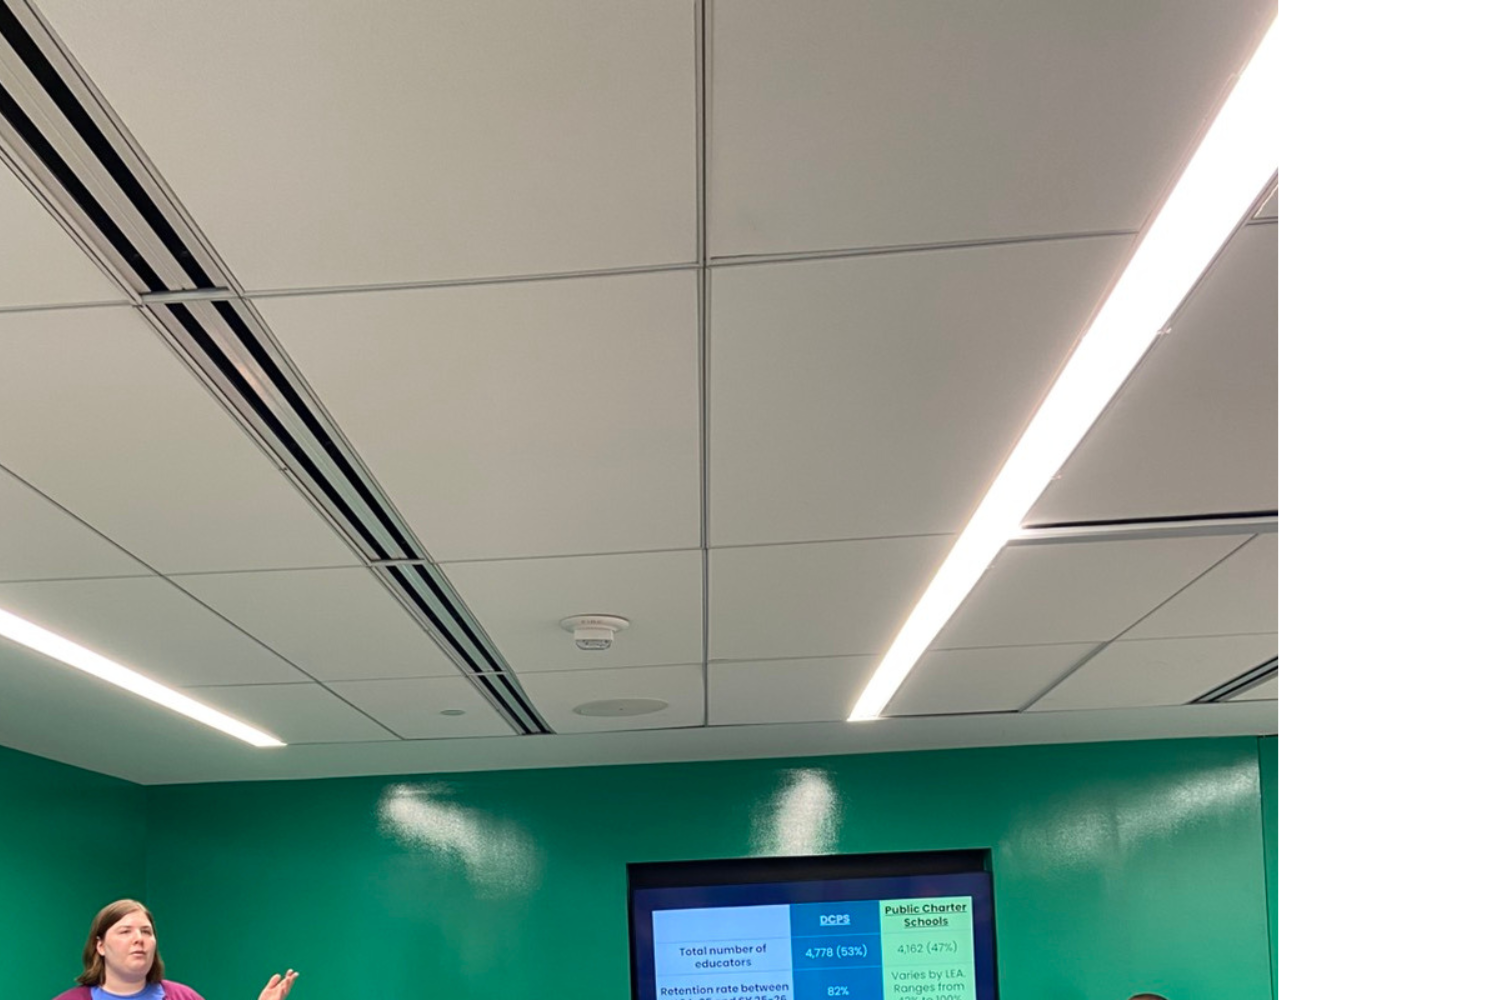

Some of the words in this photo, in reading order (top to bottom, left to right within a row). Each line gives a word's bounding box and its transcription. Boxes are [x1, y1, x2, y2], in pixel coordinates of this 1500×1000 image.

[885, 904, 920, 915] Public
[922, 903, 967, 914] Charter
[820, 914, 851, 926] DCPS
[904, 916, 949, 928] Schools
[679, 946, 706, 957] Total
[709, 944, 753, 956] number
[755, 943, 767, 953] of
[805, 948, 833, 960] 4,778
[837, 943, 868, 959] (53%)
[897, 943, 923, 955] 4,162
[926, 940, 957, 954] (47%)
[695, 958, 752, 969] educators
[891, 970, 926, 981] Varies
[928, 969, 943, 981] by
[945, 968, 966, 978] LEA.
[660, 984, 713, 996] Retention
[716, 984, 739, 994] rate
[740, 982, 789, 993] between
[827, 986, 849, 996] 82%
[894, 983, 936, 995] Ranges
[938, 982, 964, 992] from
